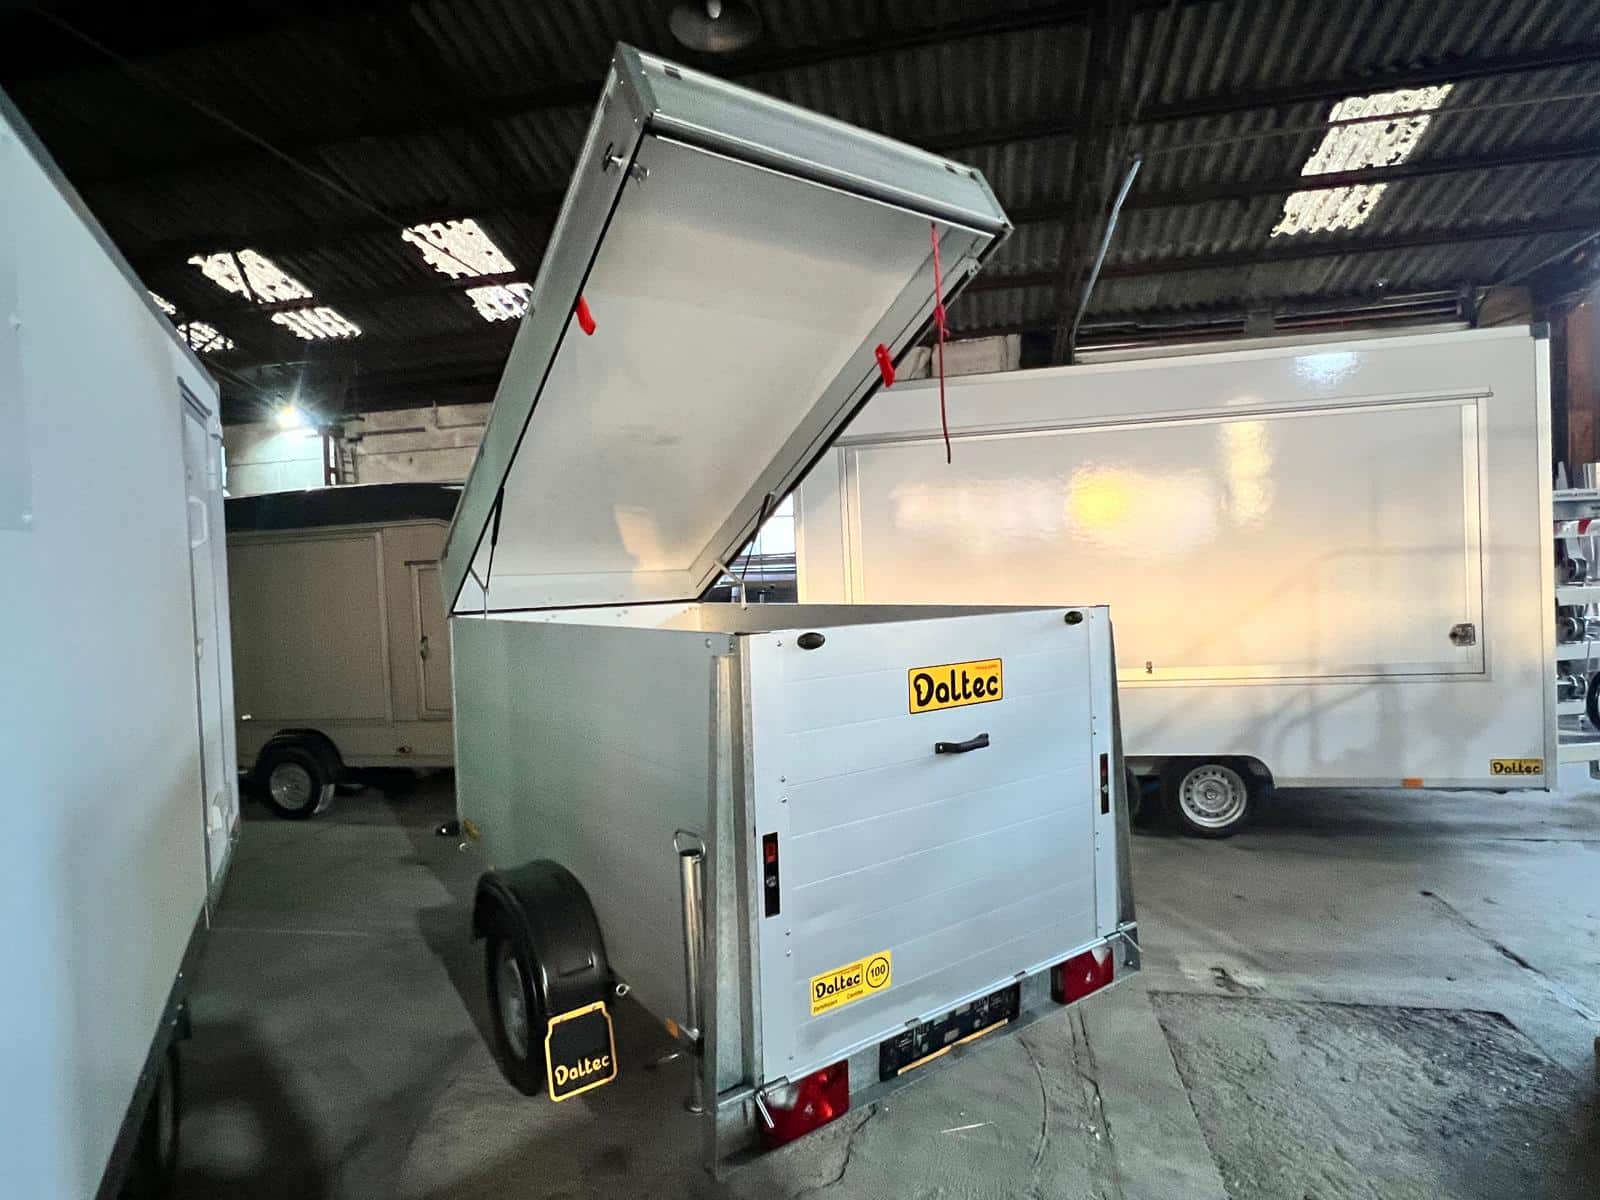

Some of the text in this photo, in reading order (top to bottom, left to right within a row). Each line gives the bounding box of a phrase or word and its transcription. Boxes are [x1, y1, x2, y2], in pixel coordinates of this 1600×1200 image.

[913, 669, 998, 707] Daltec
[870, 964, 886, 978] 100
[815, 974, 860, 998] Daltec
[554, 1055, 610, 1087] Daltec
